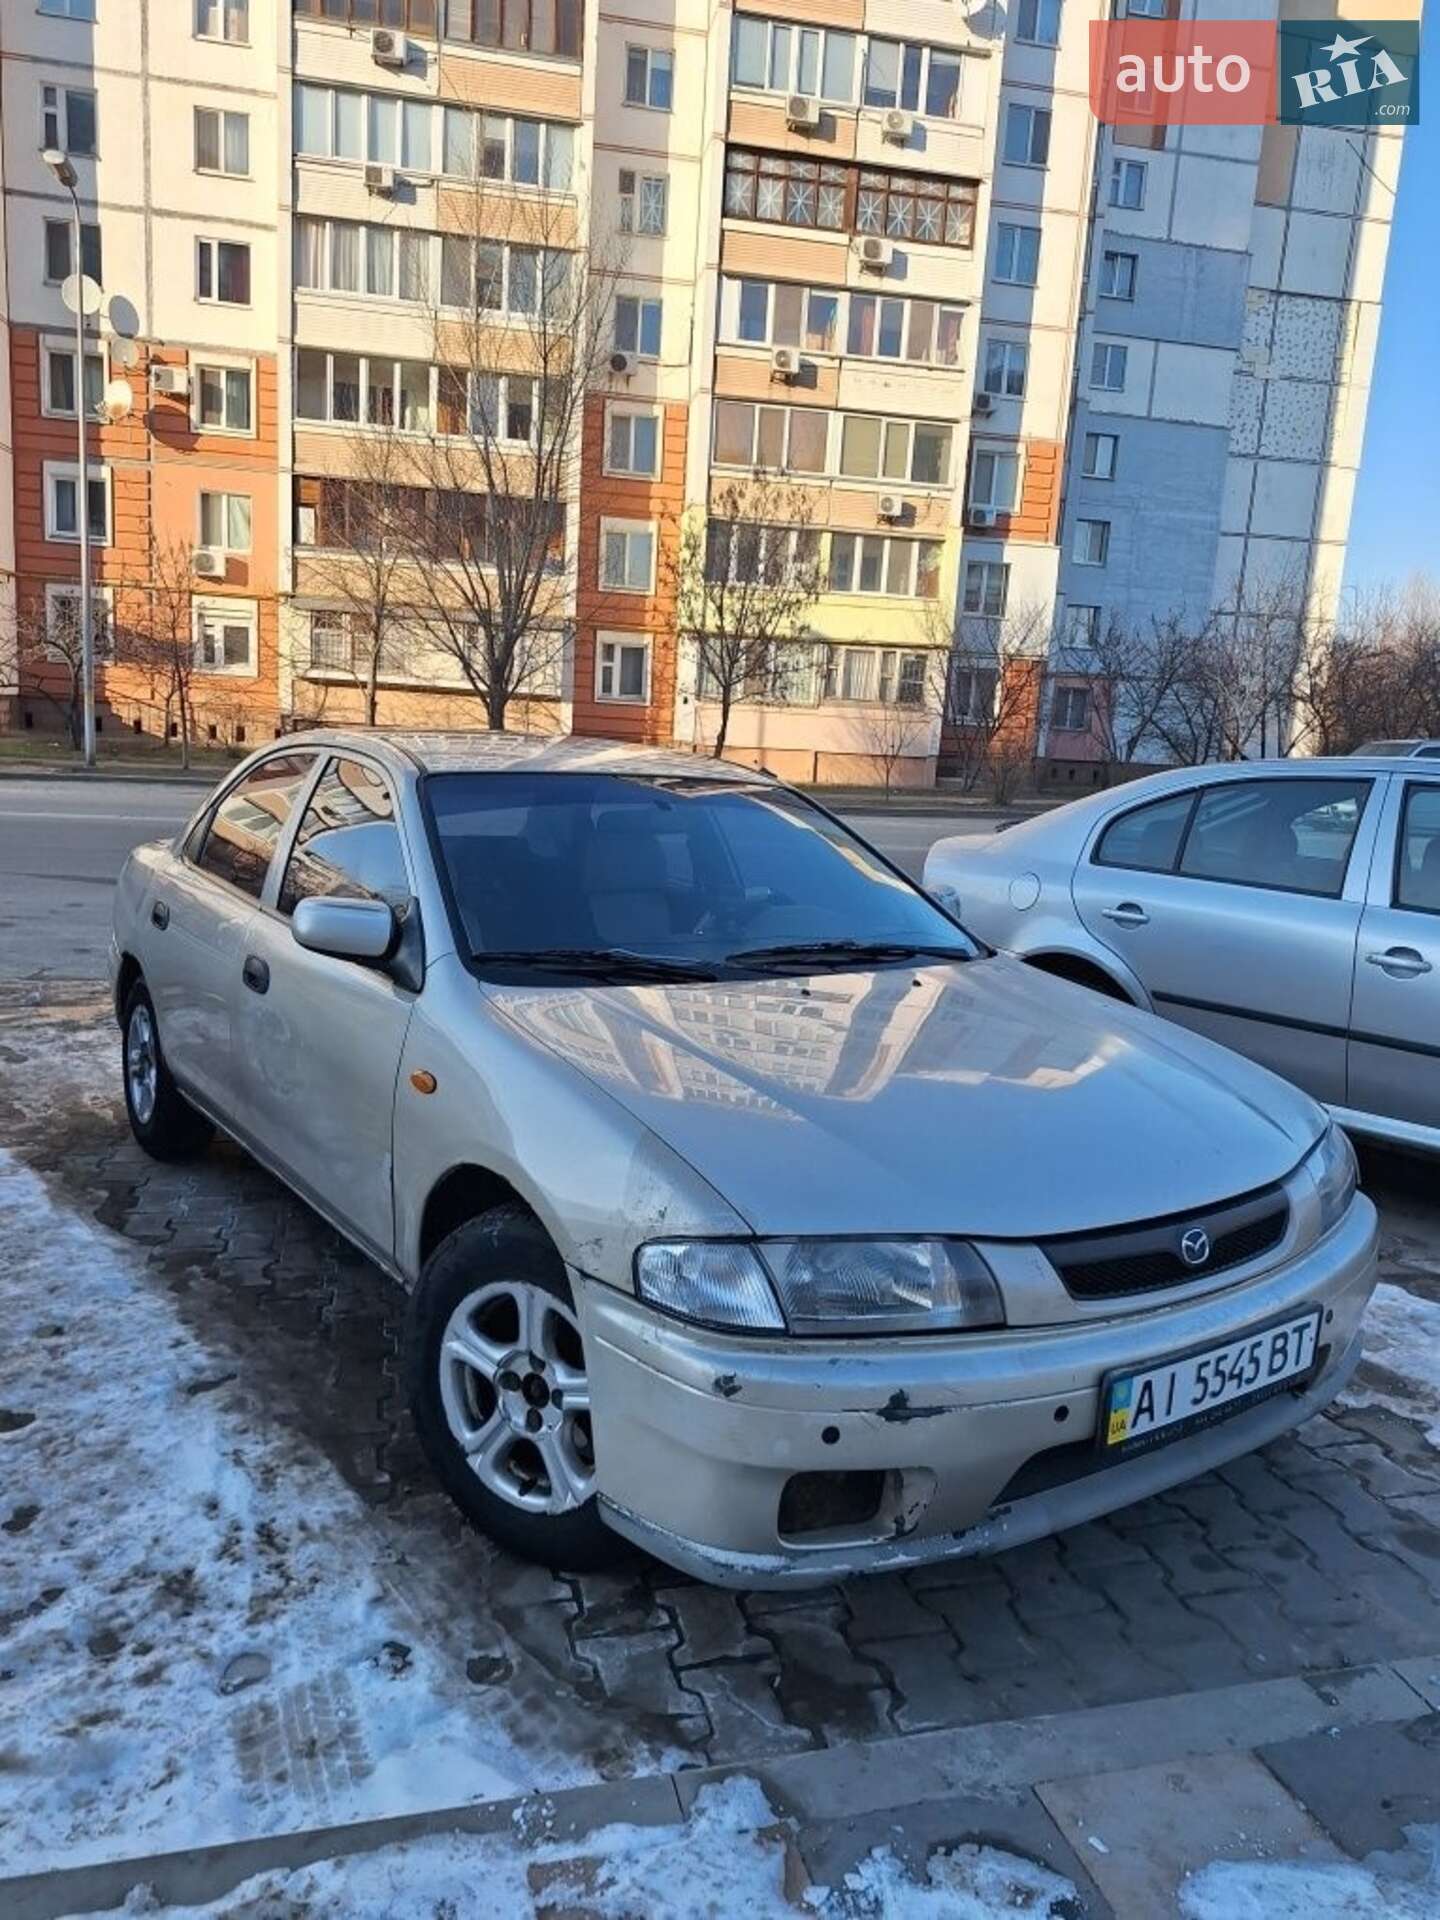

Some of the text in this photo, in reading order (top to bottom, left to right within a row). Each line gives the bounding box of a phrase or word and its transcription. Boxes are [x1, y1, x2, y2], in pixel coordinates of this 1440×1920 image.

[1131, 1372, 1176, 1429] AI
[1190, 1342, 1265, 1406] 5545
[1267, 1321, 1312, 1377] BT
[1111, 1417, 1127, 1434] UA
